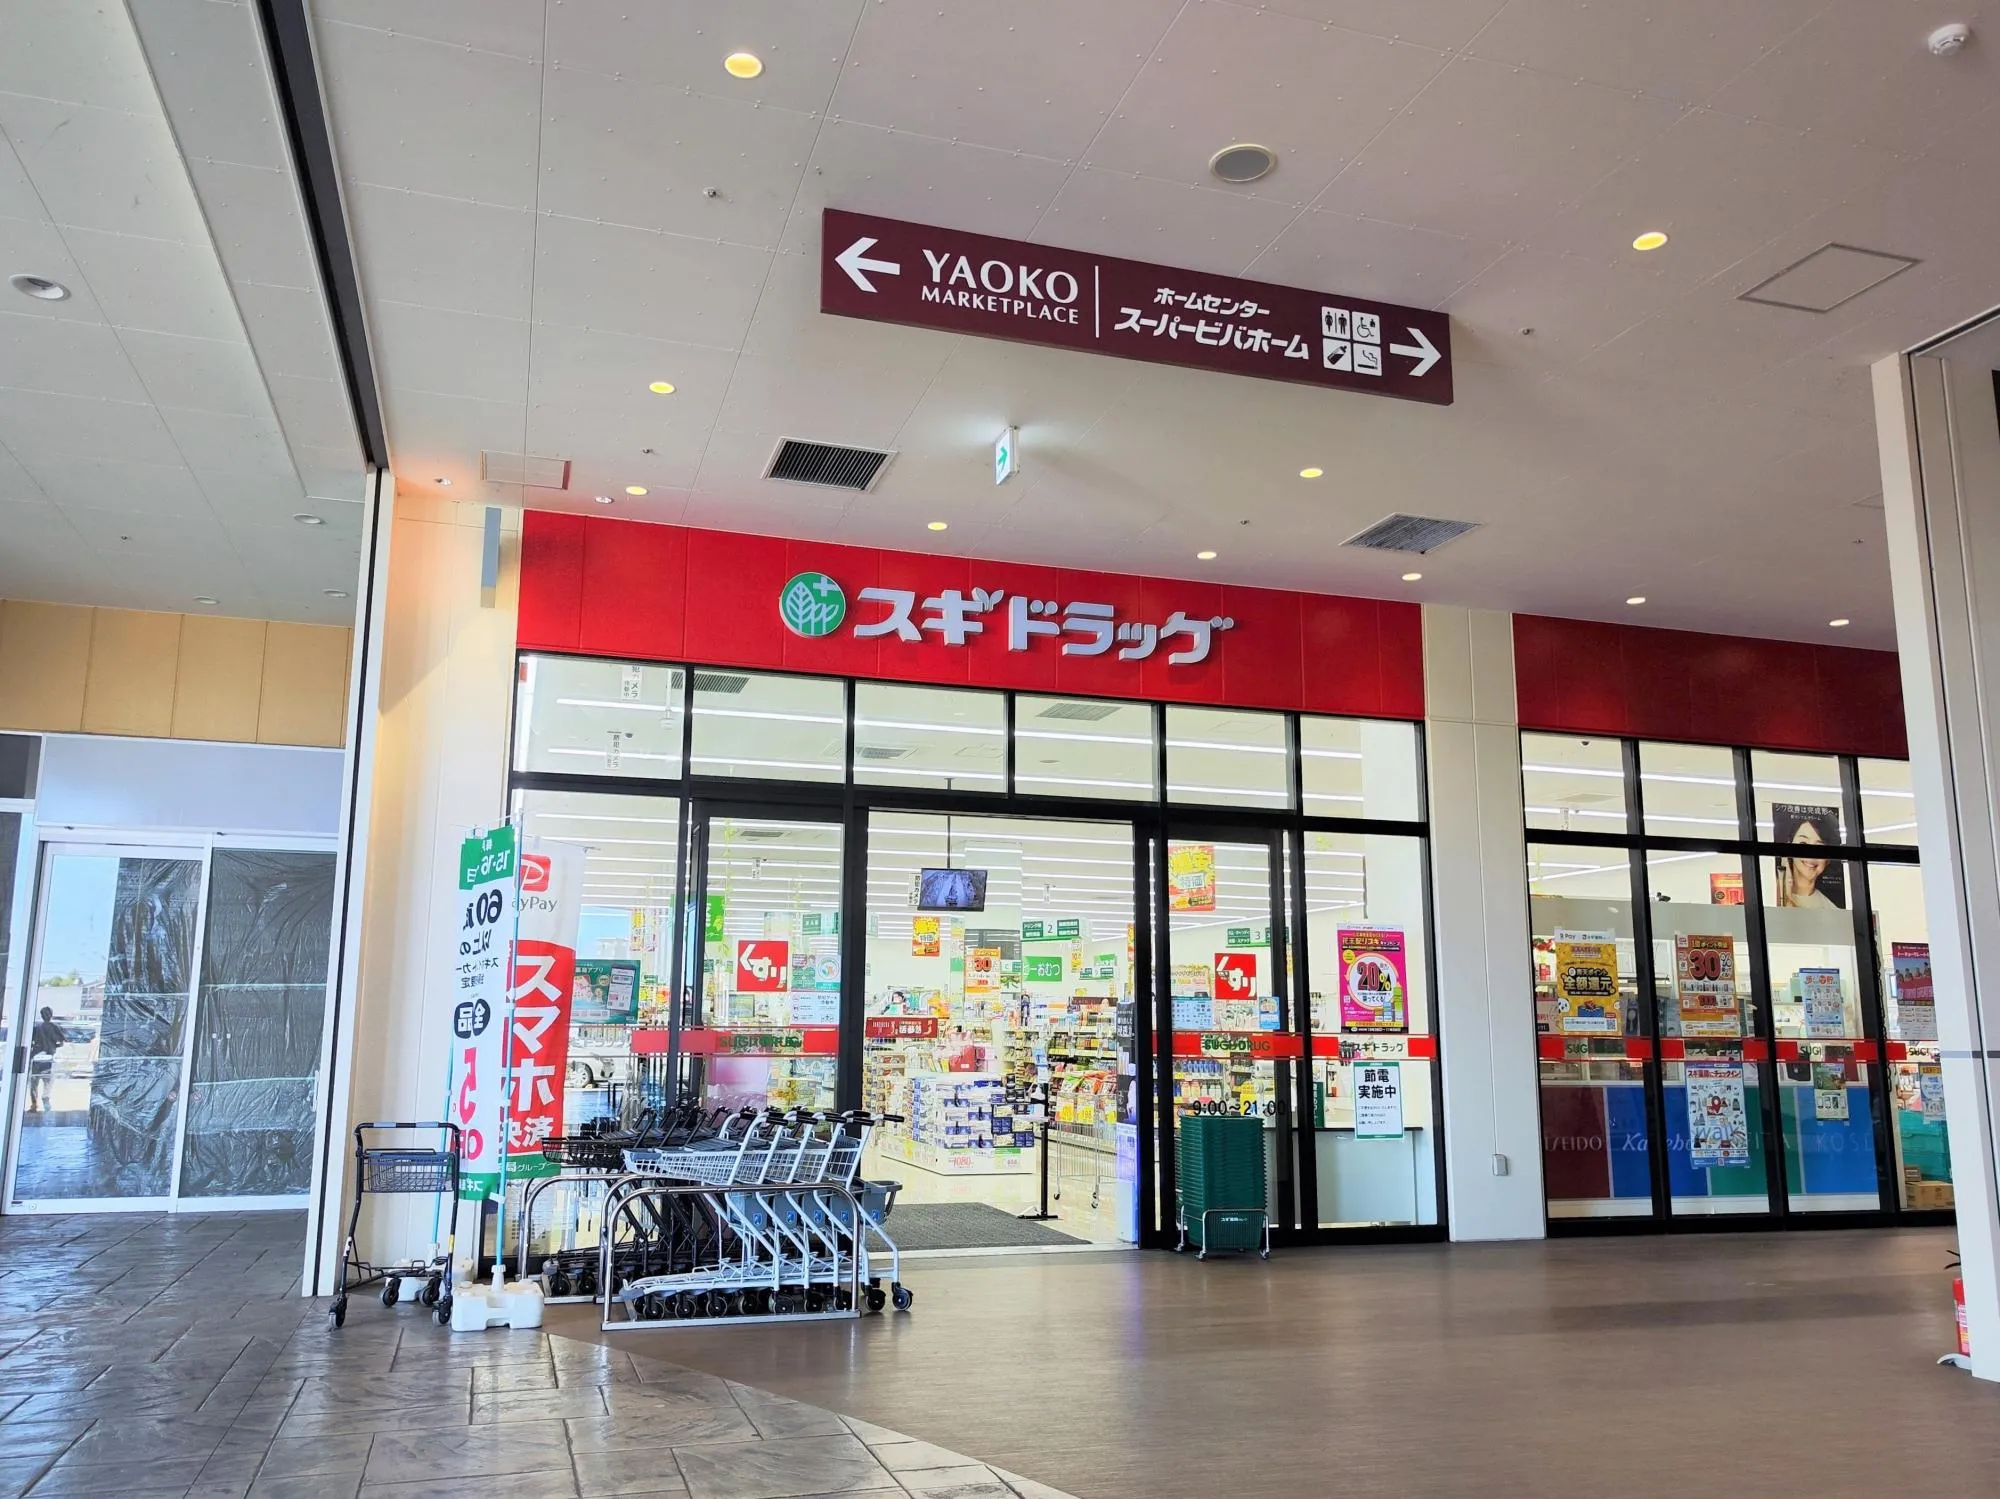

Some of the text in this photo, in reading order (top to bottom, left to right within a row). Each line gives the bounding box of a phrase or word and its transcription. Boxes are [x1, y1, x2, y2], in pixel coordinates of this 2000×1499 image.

[922, 248, 1079, 304] YAOKO
[921, 285, 1079, 325] MARKETPLACE
[1154, 287, 1270, 319] ホームセンター
[1113, 306, 1310, 360] スーパービバホーム
[853, 587, 1235, 665] スギドラッグ
[511, 896, 558, 913] ayPay
[739, 943, 787, 988] くすり
[500, 955, 563, 1112] スマホ
[1358, 1085, 1397, 1099] 実施中
[1363, 1068, 1390, 1083] 節電
